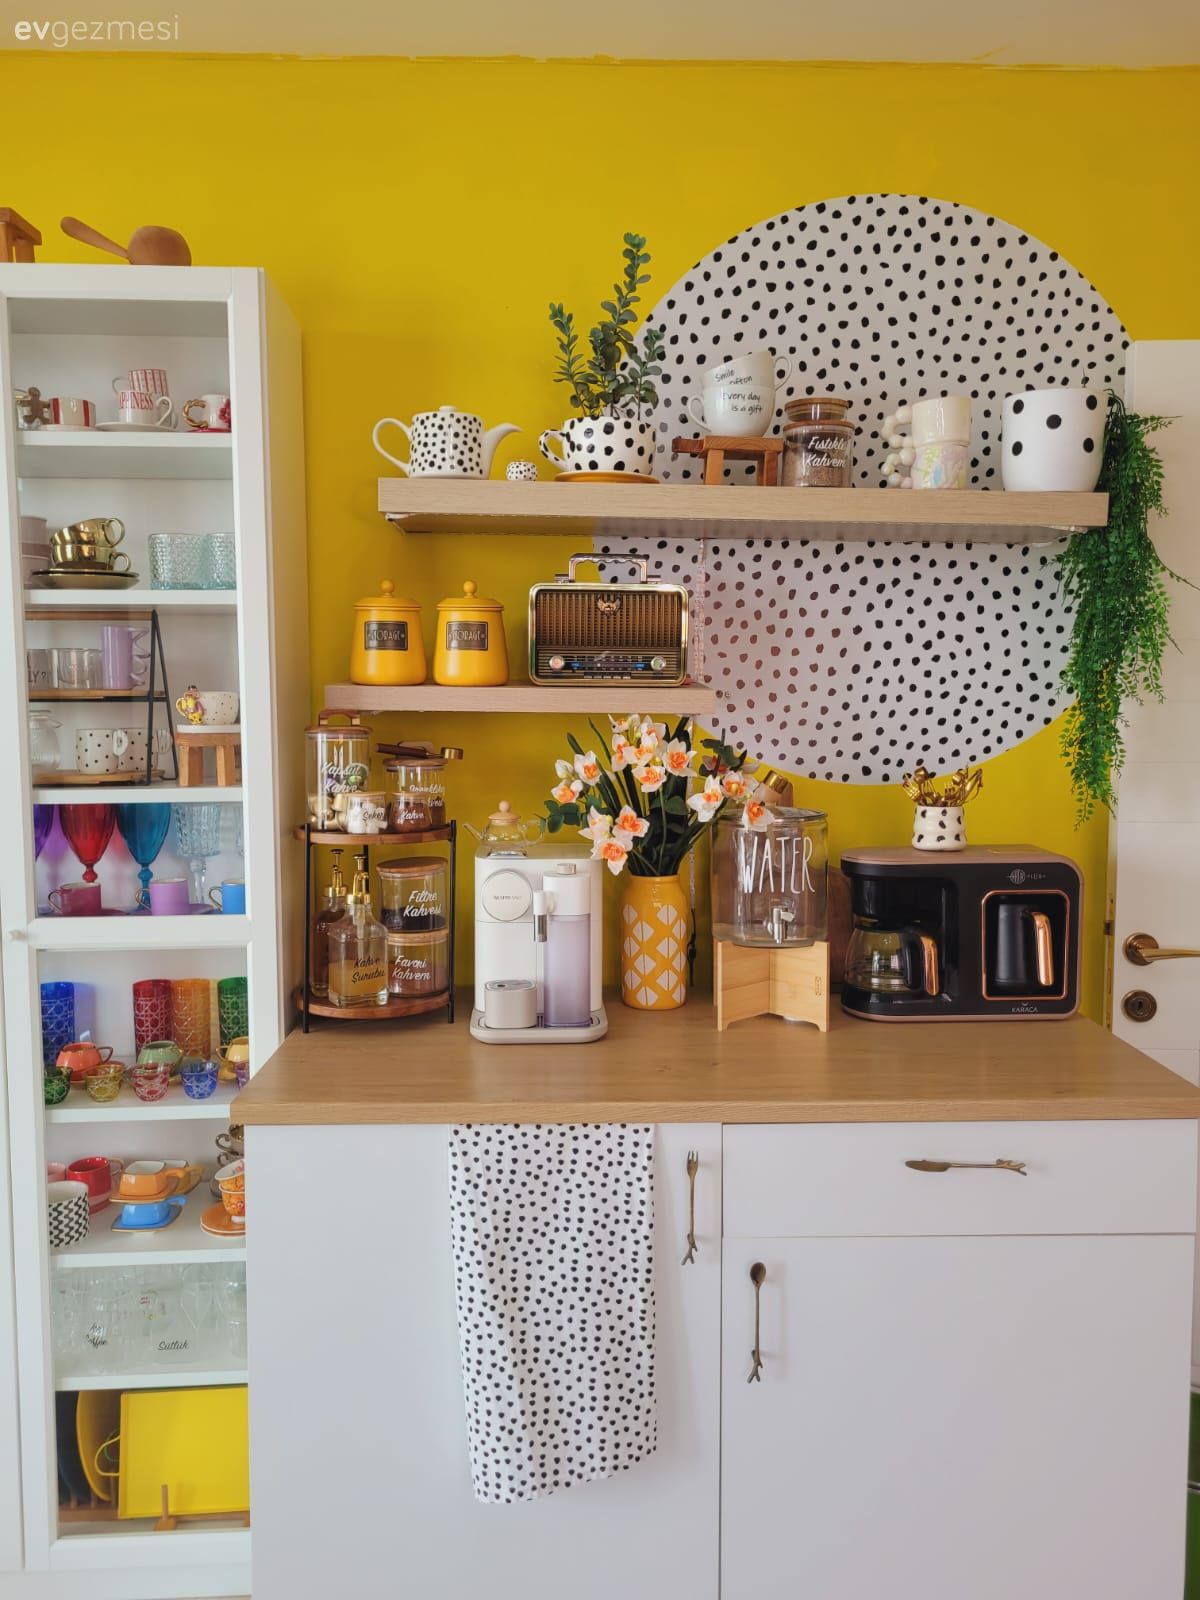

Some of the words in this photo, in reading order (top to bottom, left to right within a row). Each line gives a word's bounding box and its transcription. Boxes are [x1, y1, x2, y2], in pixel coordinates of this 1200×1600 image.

[715, 369, 735, 382] Smile
[119, 391, 154, 410] PPINESS
[722, 392, 745, 401] Every
[747, 391, 761, 403] day
[747, 403, 762, 415] gift
[805, 452, 846, 468] Kahvem
[324, 780, 358, 793] Kahve
[399, 809, 424, 821] Kahve
[740, 835, 816, 894] WATER
[408, 888, 438, 903] Filtre
[403, 903, 442, 917] Kahvesi
[394, 954, 427, 969] Favori
[391, 966, 431, 980] Kahvem
